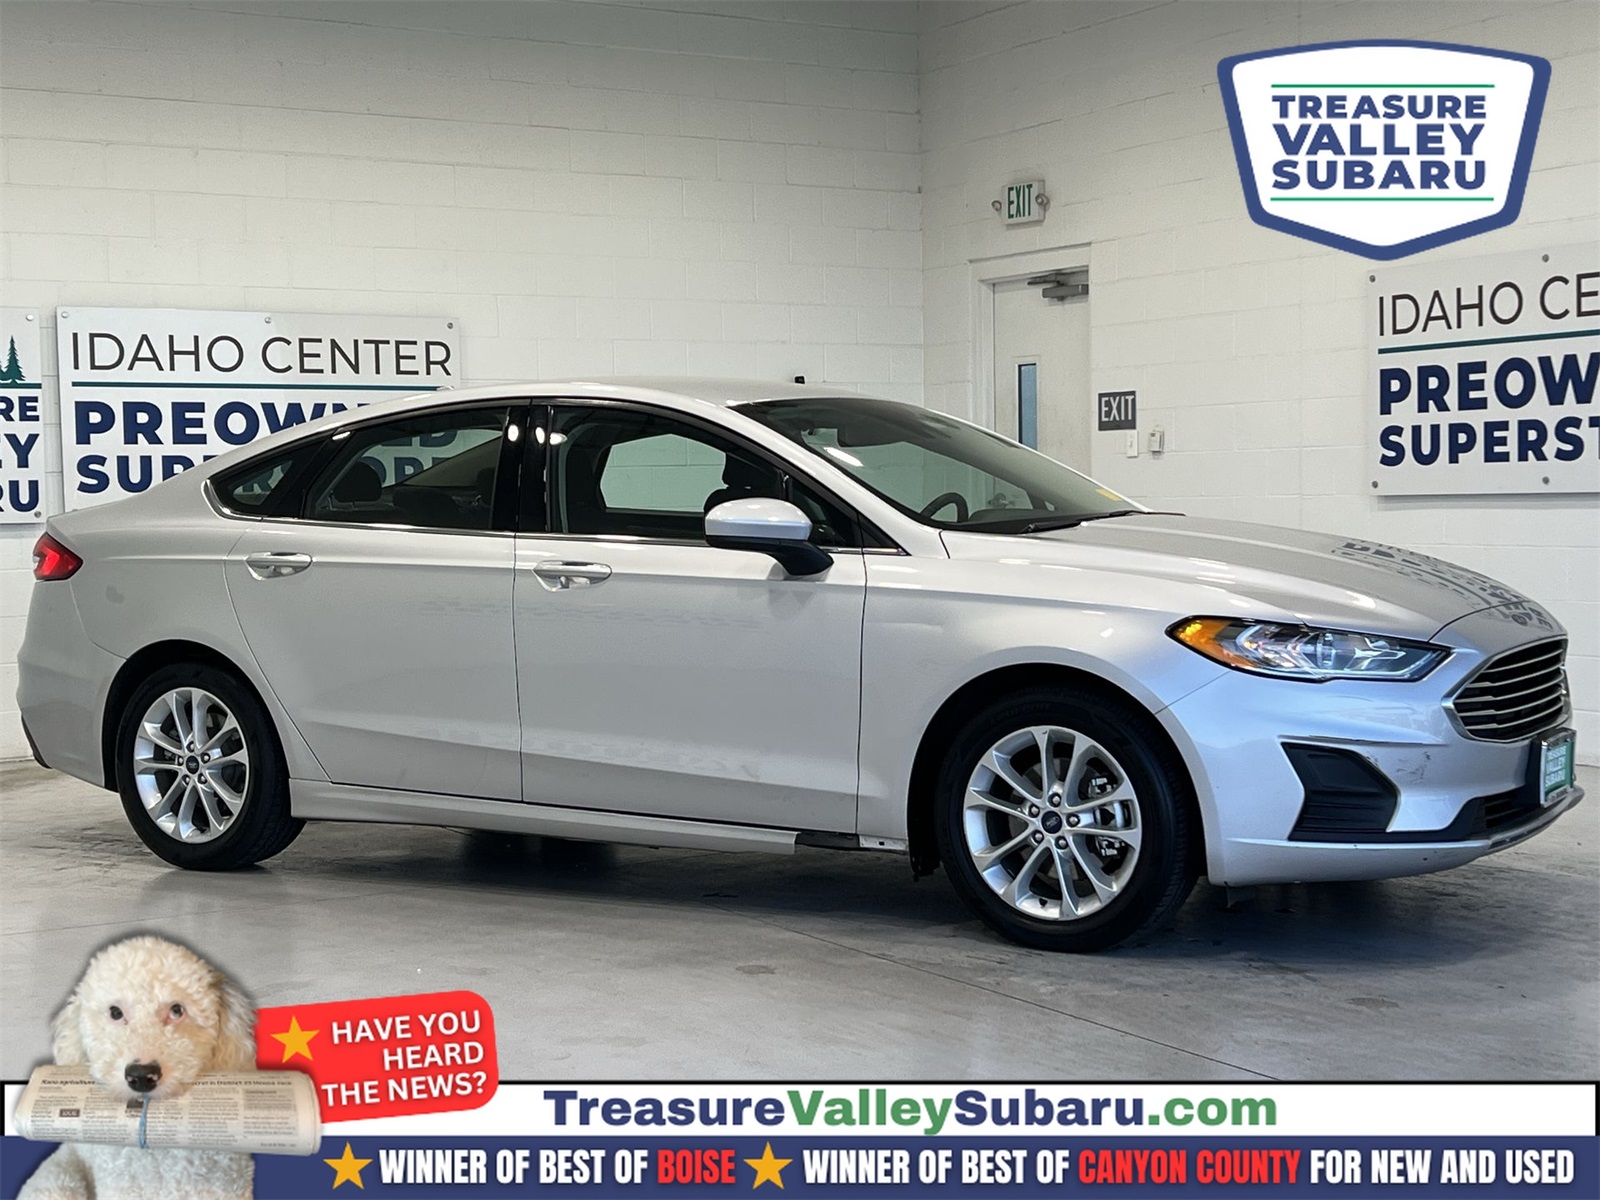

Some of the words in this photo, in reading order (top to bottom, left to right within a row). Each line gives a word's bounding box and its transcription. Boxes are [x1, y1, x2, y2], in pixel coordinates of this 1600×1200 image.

[1007, 183, 1033, 219] EXIT
[1378, 281, 1524, 337] IDAHO
[72, 332, 244, 373] IDAHO
[261, 336, 452, 376] CENTER
[1101, 394, 1135, 421] EXIT
